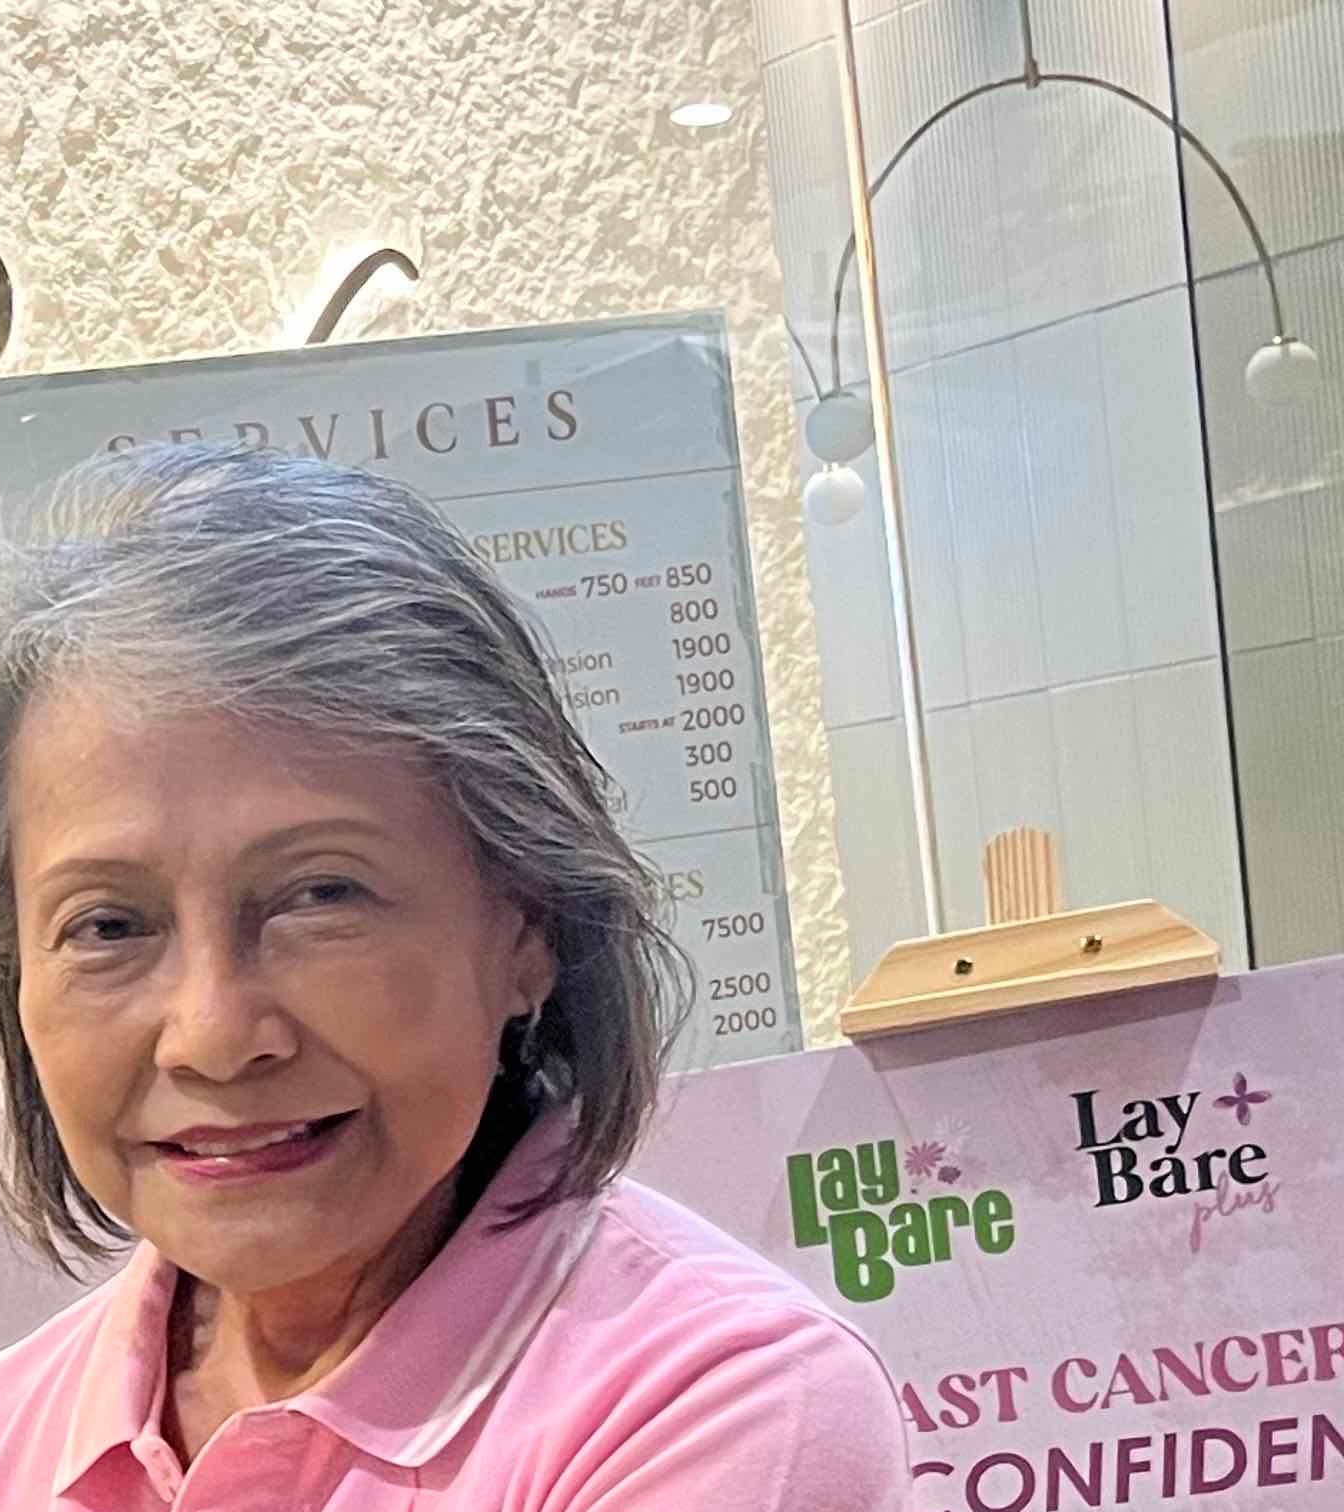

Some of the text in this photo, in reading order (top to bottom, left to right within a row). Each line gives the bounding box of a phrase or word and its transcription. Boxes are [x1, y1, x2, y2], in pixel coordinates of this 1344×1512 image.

[580, 572, 628, 598] 750
[665, 562, 712, 588] 850
[670, 598, 718, 624] 800
[672, 632, 731, 660] 1900
[676, 669, 735, 695] 1900
[681, 704, 745, 731] 2000
[685, 741, 732, 766] 300
[690, 777, 736, 802] 500
[702, 912, 764, 941] 7500
[709, 972, 770, 1001] 2500
[714, 1008, 776, 1036] 2000
[1070, 1089, 1200, 1153] Lay
[1089, 1142, 1269, 1207] Bare
[786, 1139, 900, 1249] Lay
[1189, 1172, 1281, 1253] plus
[829, 1188, 1014, 1302] Bare
